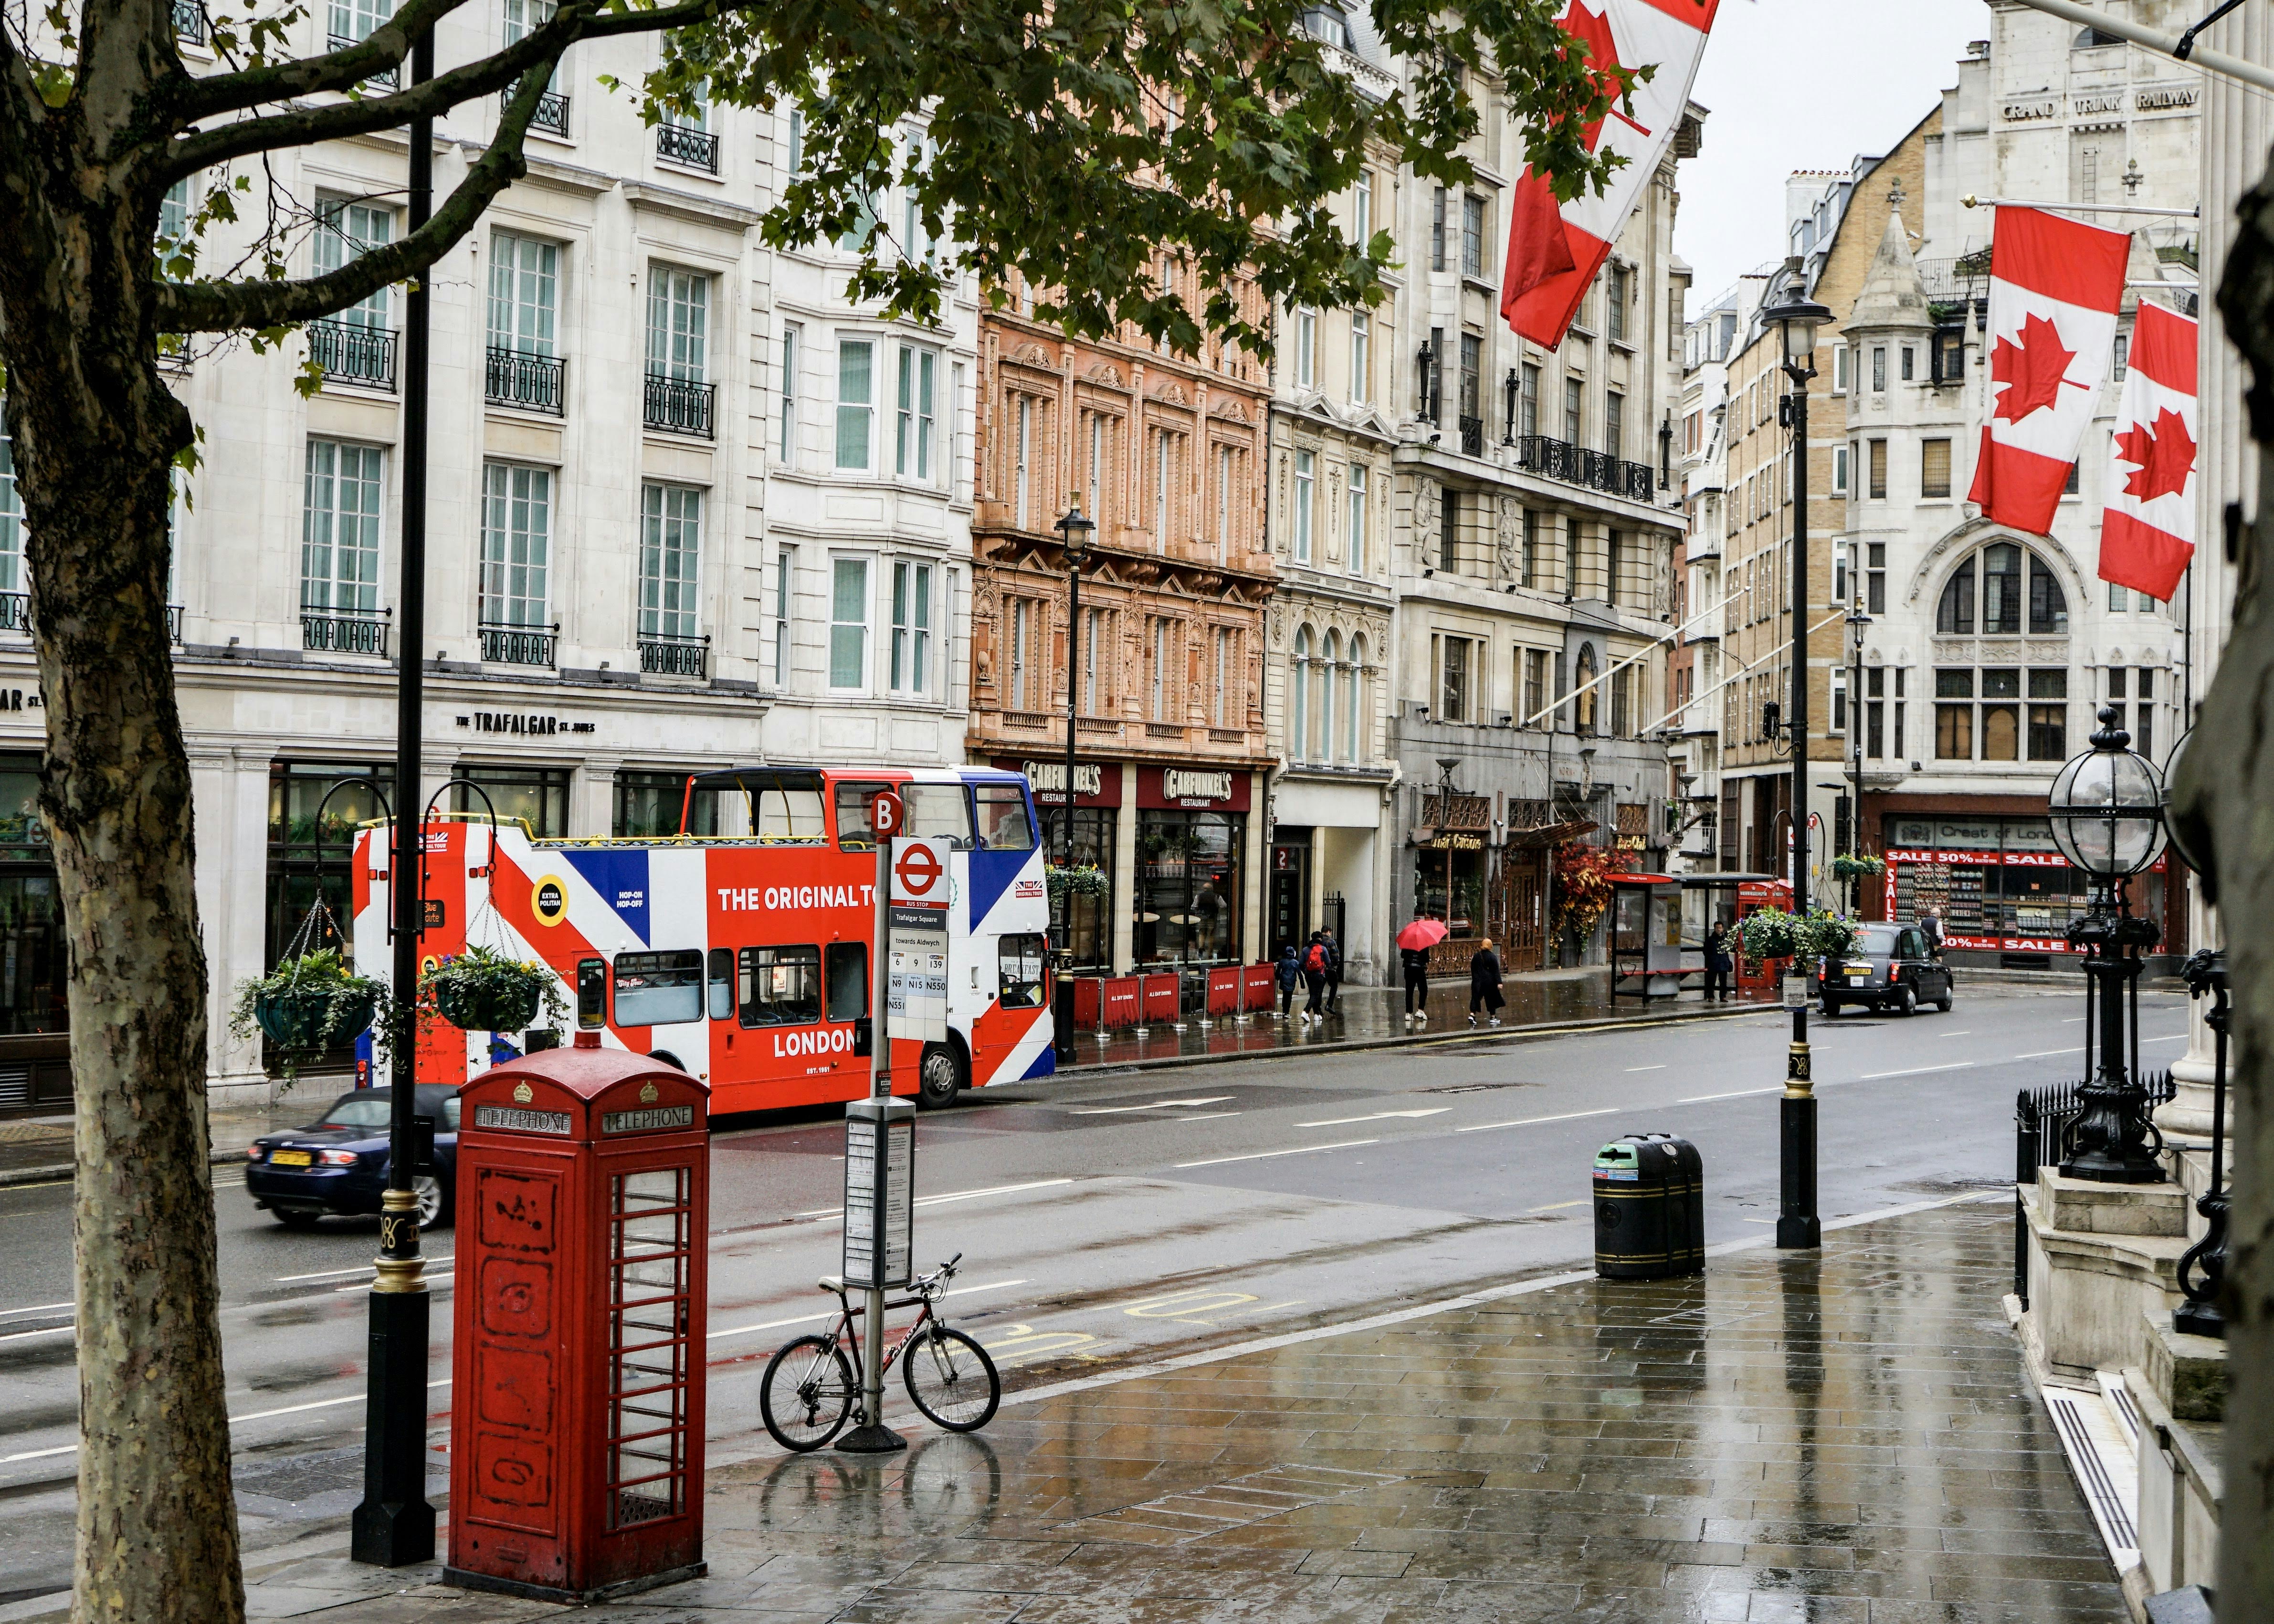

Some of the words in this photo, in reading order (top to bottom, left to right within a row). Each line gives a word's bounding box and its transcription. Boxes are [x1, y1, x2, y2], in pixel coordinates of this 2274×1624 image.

[2002, 103, 2056, 119] GRAND
[2074, 96, 2121, 113] TRUNK
[2136, 90, 2200, 108] RAILWAY
[456, 716, 470, 726] THE
[474, 712, 556, 734] TRAFALGAR
[1028, 762, 1101, 795] GARFUKEL'S
[1169, 769, 1232, 800] GARFUNKEL'S
[1042, 793, 1076, 803] RESTAURT
[1180, 798, 1211, 807] RESTAURANT
[877, 799, 893, 829] B
[1942, 825, 1988, 838] Crest
[1887, 851, 1932, 861] SALE
[1938, 853, 1974, 863] 50%
[2005, 854, 2065, 866] SALE
[616, 900, 643, 908] HOP-OFF
[717, 888, 759, 911] THE
[764, 885, 859, 910] ORIGINAL
[895, 913, 918, 922] Trafalgar
[918, 915, 938, 924] Square
[2004, 940, 2065, 951] SALE
[895, 958, 900, 966] 6
[930, 961, 942, 969] 139
[617, 979, 630, 987] City
[892, 979, 902, 988] N9
[909, 981, 922, 989] N15
[926, 982, 946, 991] N550
[889, 1001, 905, 1010] N551
[774, 1029, 855, 1058] LONDON
[482, 1108, 570, 1131] TELEPHONE
[605, 1108, 689, 1131] TELEPHONE
[892, 1321, 918, 1361] GIANT
